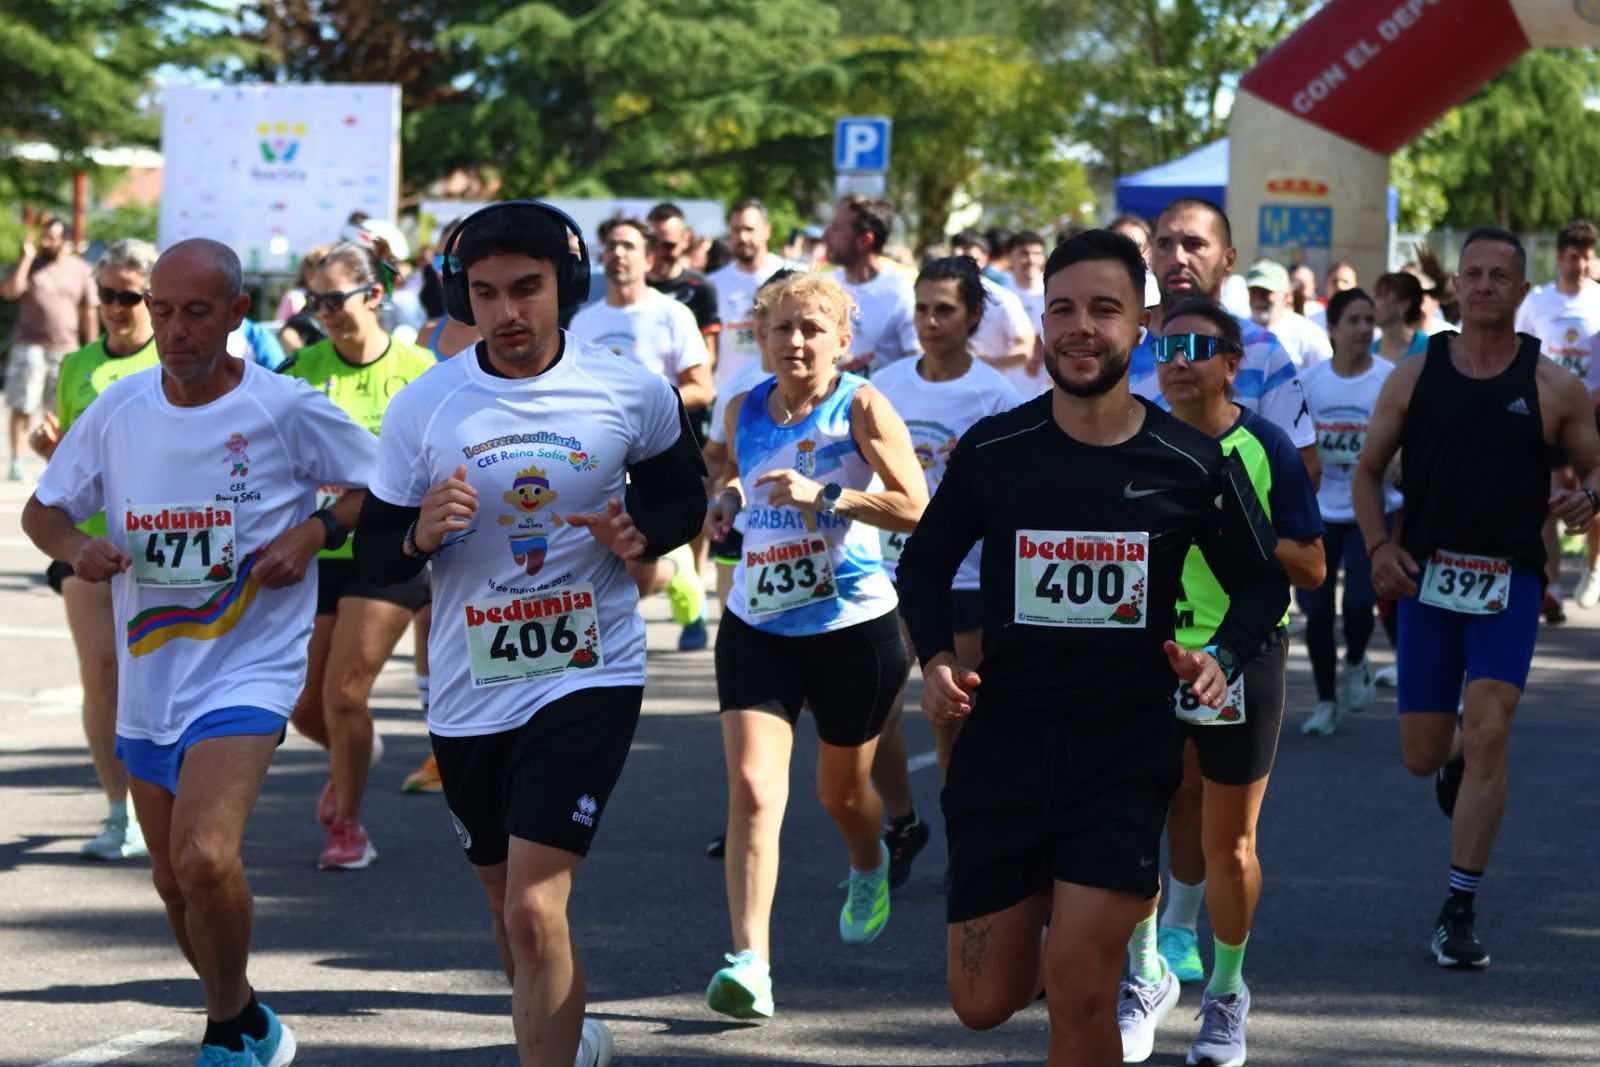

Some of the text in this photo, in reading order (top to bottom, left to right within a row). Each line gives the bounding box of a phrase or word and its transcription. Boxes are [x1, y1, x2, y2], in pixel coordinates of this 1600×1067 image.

[1293, 0, 1441, 113] CON EL DEP
[845, 124, 879, 168] P
[472, 434, 521, 455] carrera
[521, 431, 582, 451] solidaria
[477, 447, 567, 468] CEE Reina Sofía
[1322, 433, 1361, 452] 446
[230, 482, 247, 492] CEE
[126, 507, 232, 532] bedunia
[146, 530, 211, 568] 471
[747, 538, 826, 568] bedunia
[1019, 536, 1145, 562] bedunia
[487, 578, 496, 590] 16
[496, 585, 508, 593] de
[537, 583, 549, 592] de
[551, 571, 573, 588] 2026
[757, 559, 818, 597] 433
[1036, 563, 1125, 605] 400
[1437, 568, 1496, 601] 397
[465, 590, 593, 628] bedunia
[490, 615, 578, 662] 406
